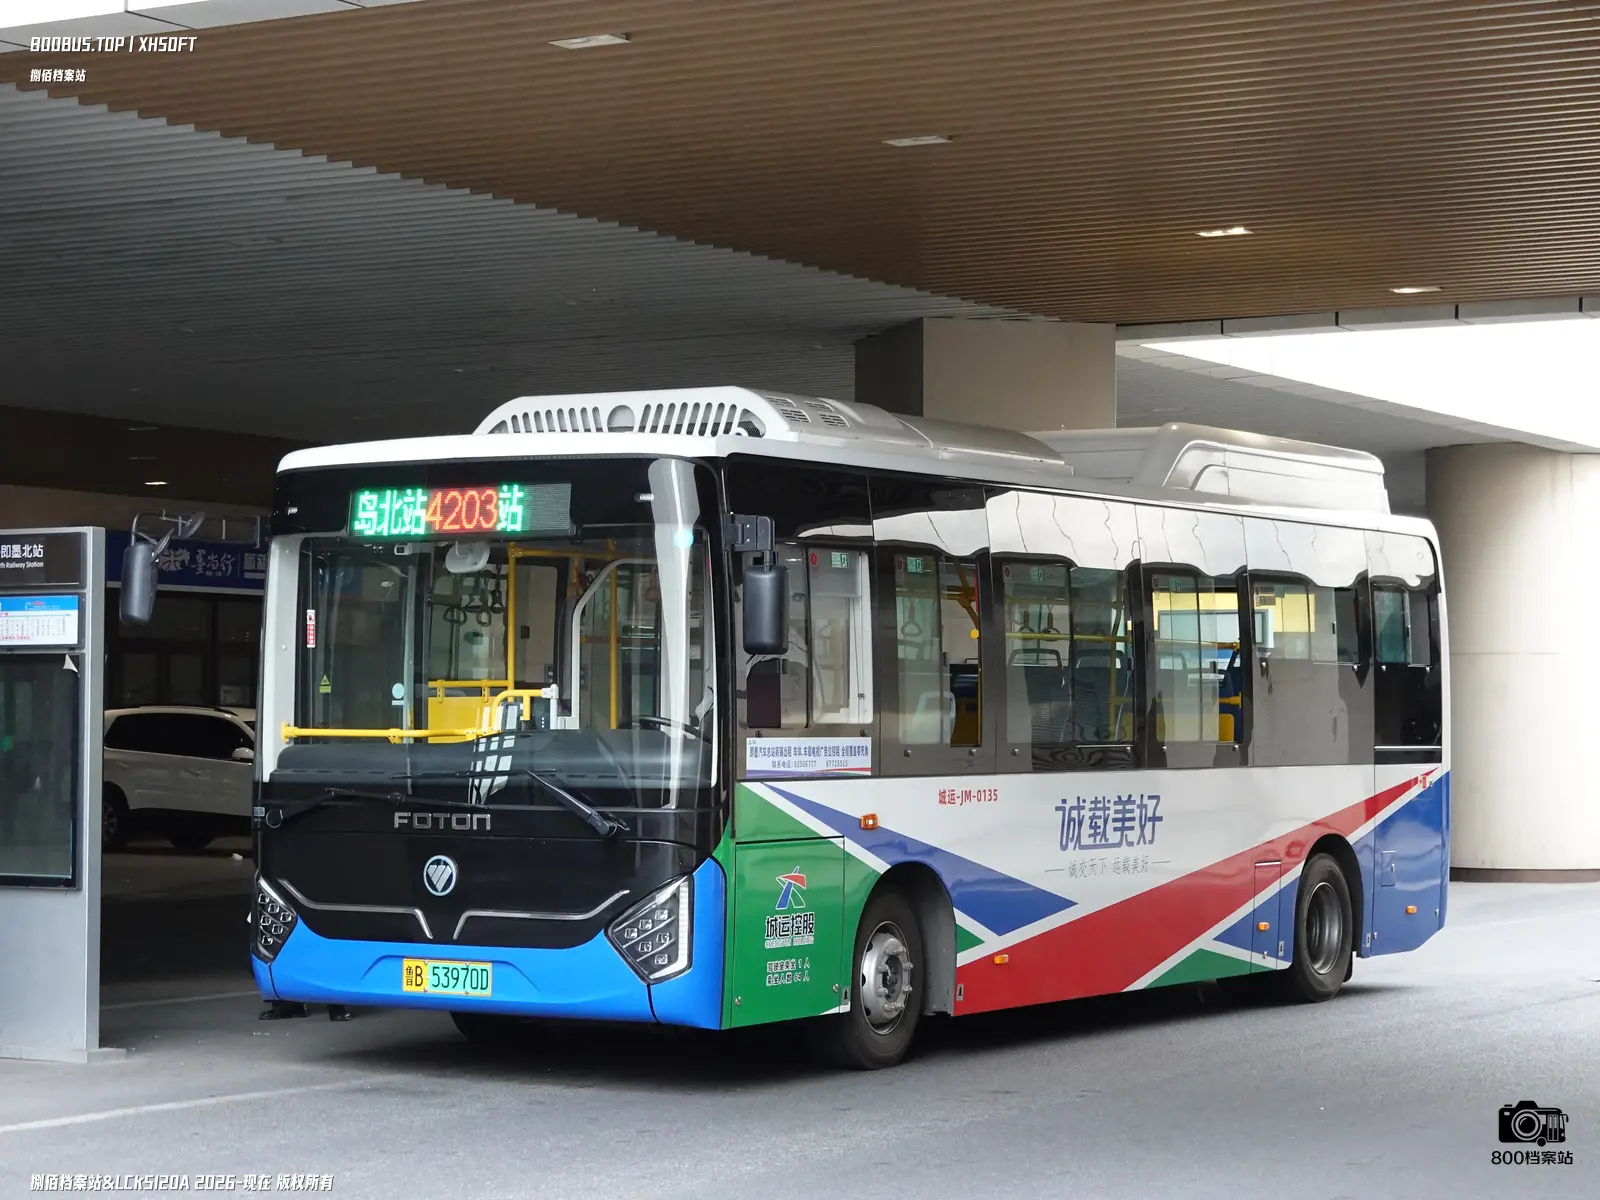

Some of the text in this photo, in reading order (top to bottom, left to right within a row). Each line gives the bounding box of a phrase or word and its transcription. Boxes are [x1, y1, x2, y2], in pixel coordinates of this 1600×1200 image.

[0, 544, 44, 558] 即墨北站
[6, 561, 26, 570] Railway
[938, 788, 998, 805] 城运-JM-0135
[393, 811, 491, 831] FOTON
[1054, 793, 1164, 852] 诚载美好
[765, 912, 815, 939] 城运控股
[803, 956, 811, 969] 人
[803, 970, 810, 982] 人
